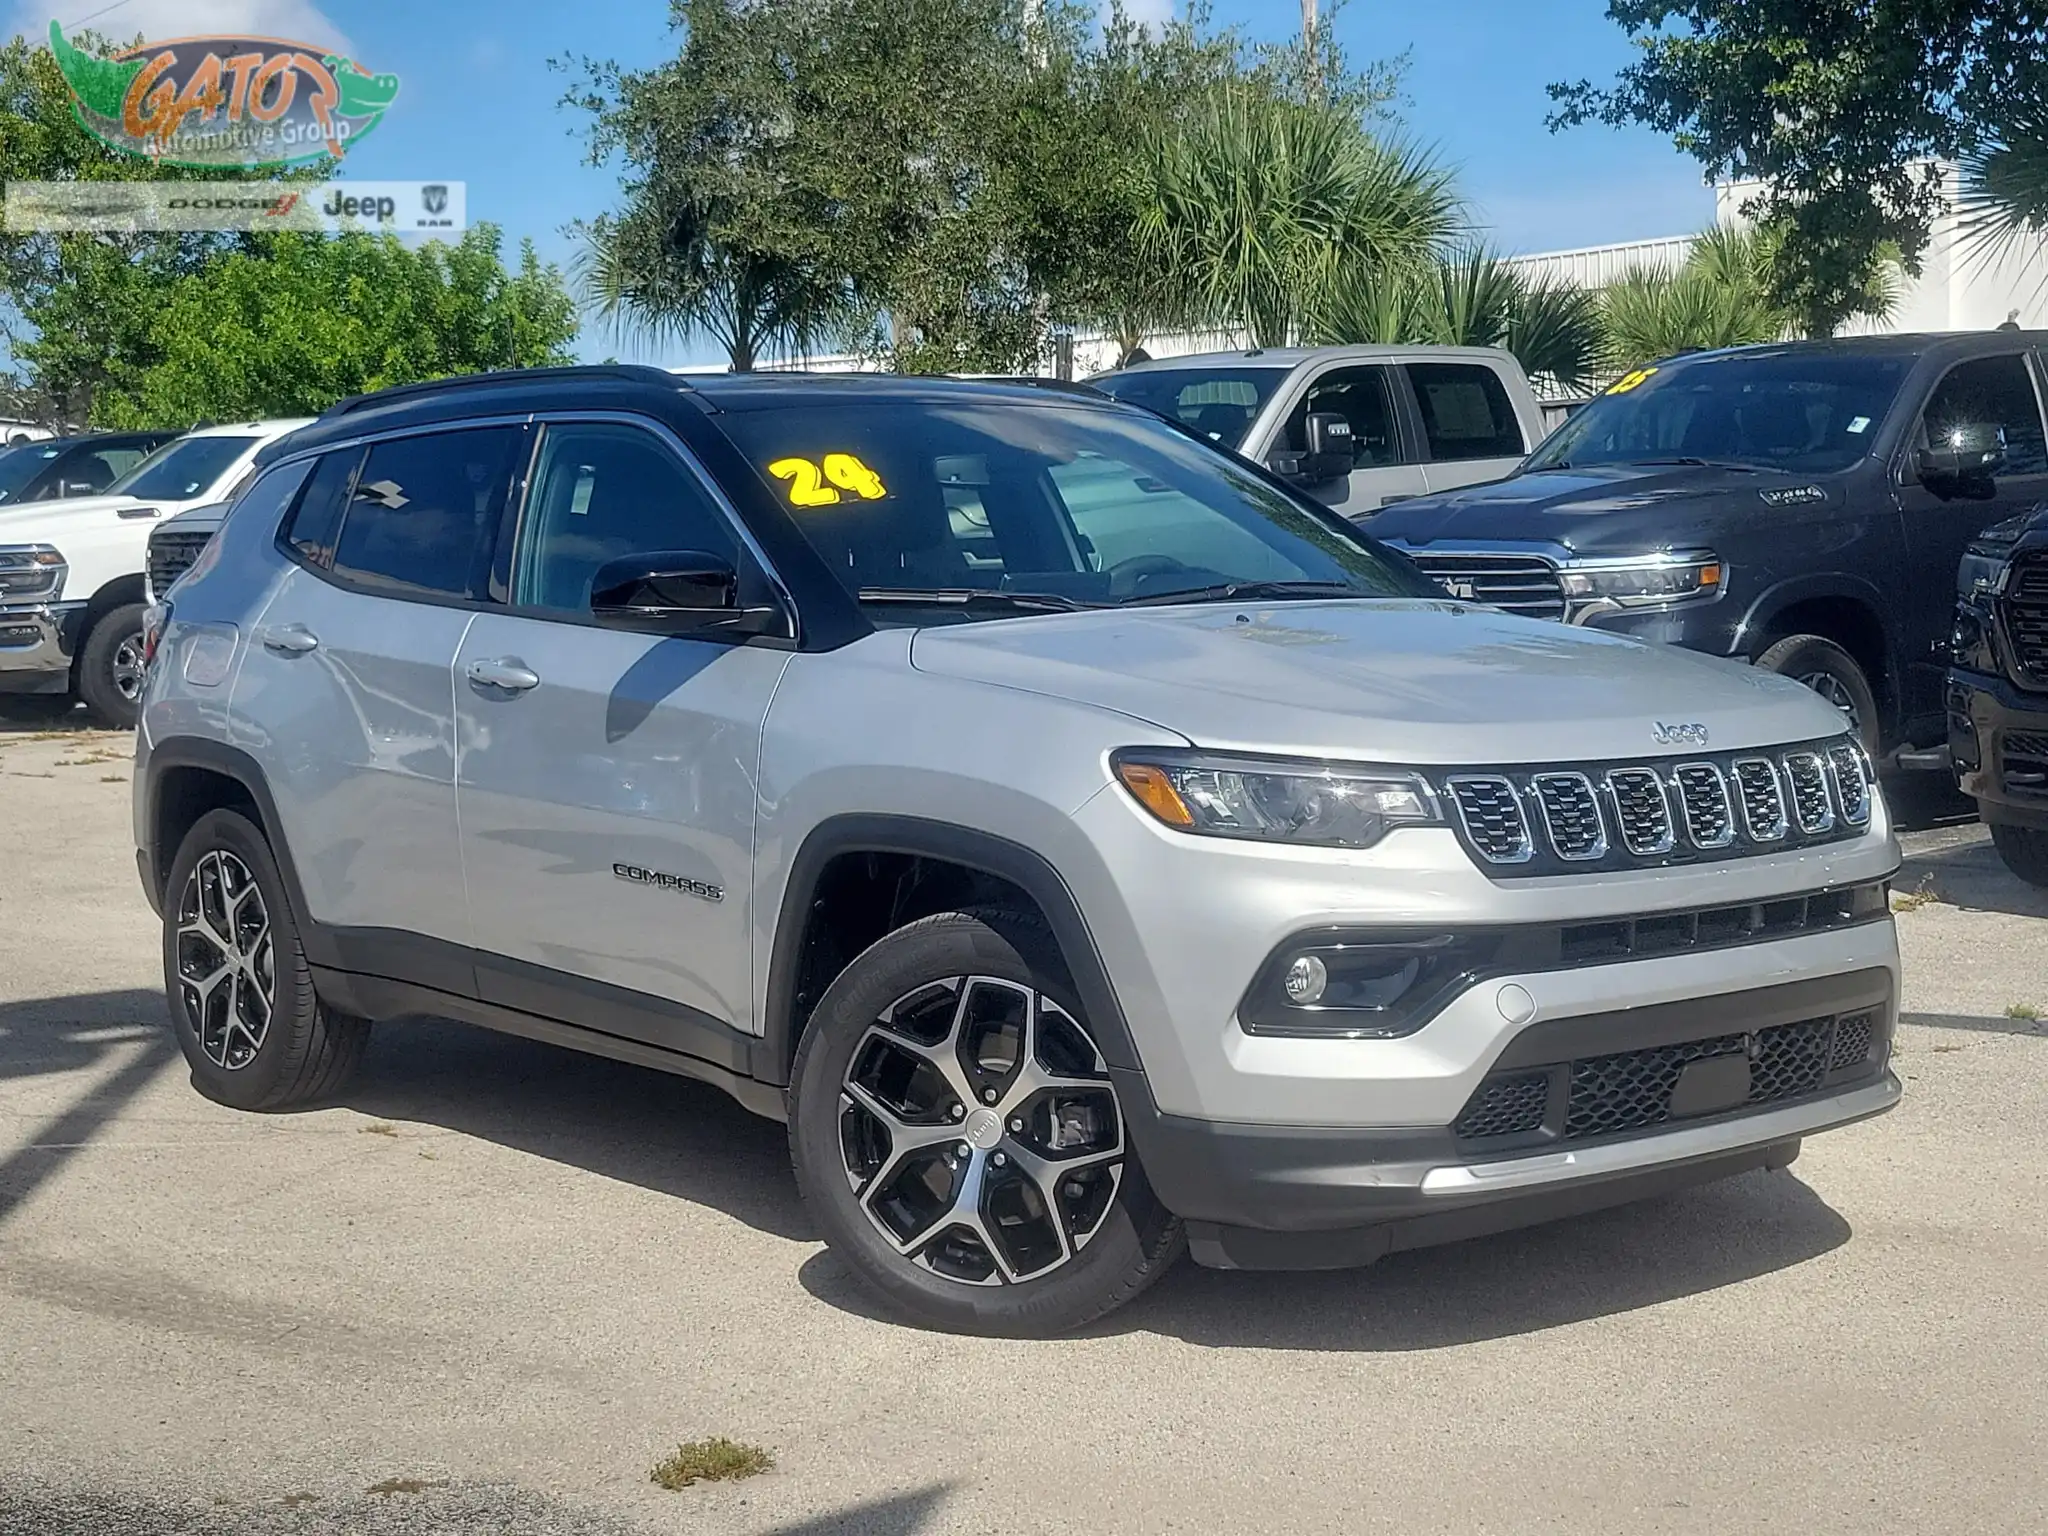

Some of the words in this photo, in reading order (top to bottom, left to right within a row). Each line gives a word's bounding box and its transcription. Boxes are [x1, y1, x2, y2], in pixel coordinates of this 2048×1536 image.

[768, 454, 887, 507] 24
[1651, 720, 1708, 746] Jeep
[612, 863, 724, 901] COMPASS
